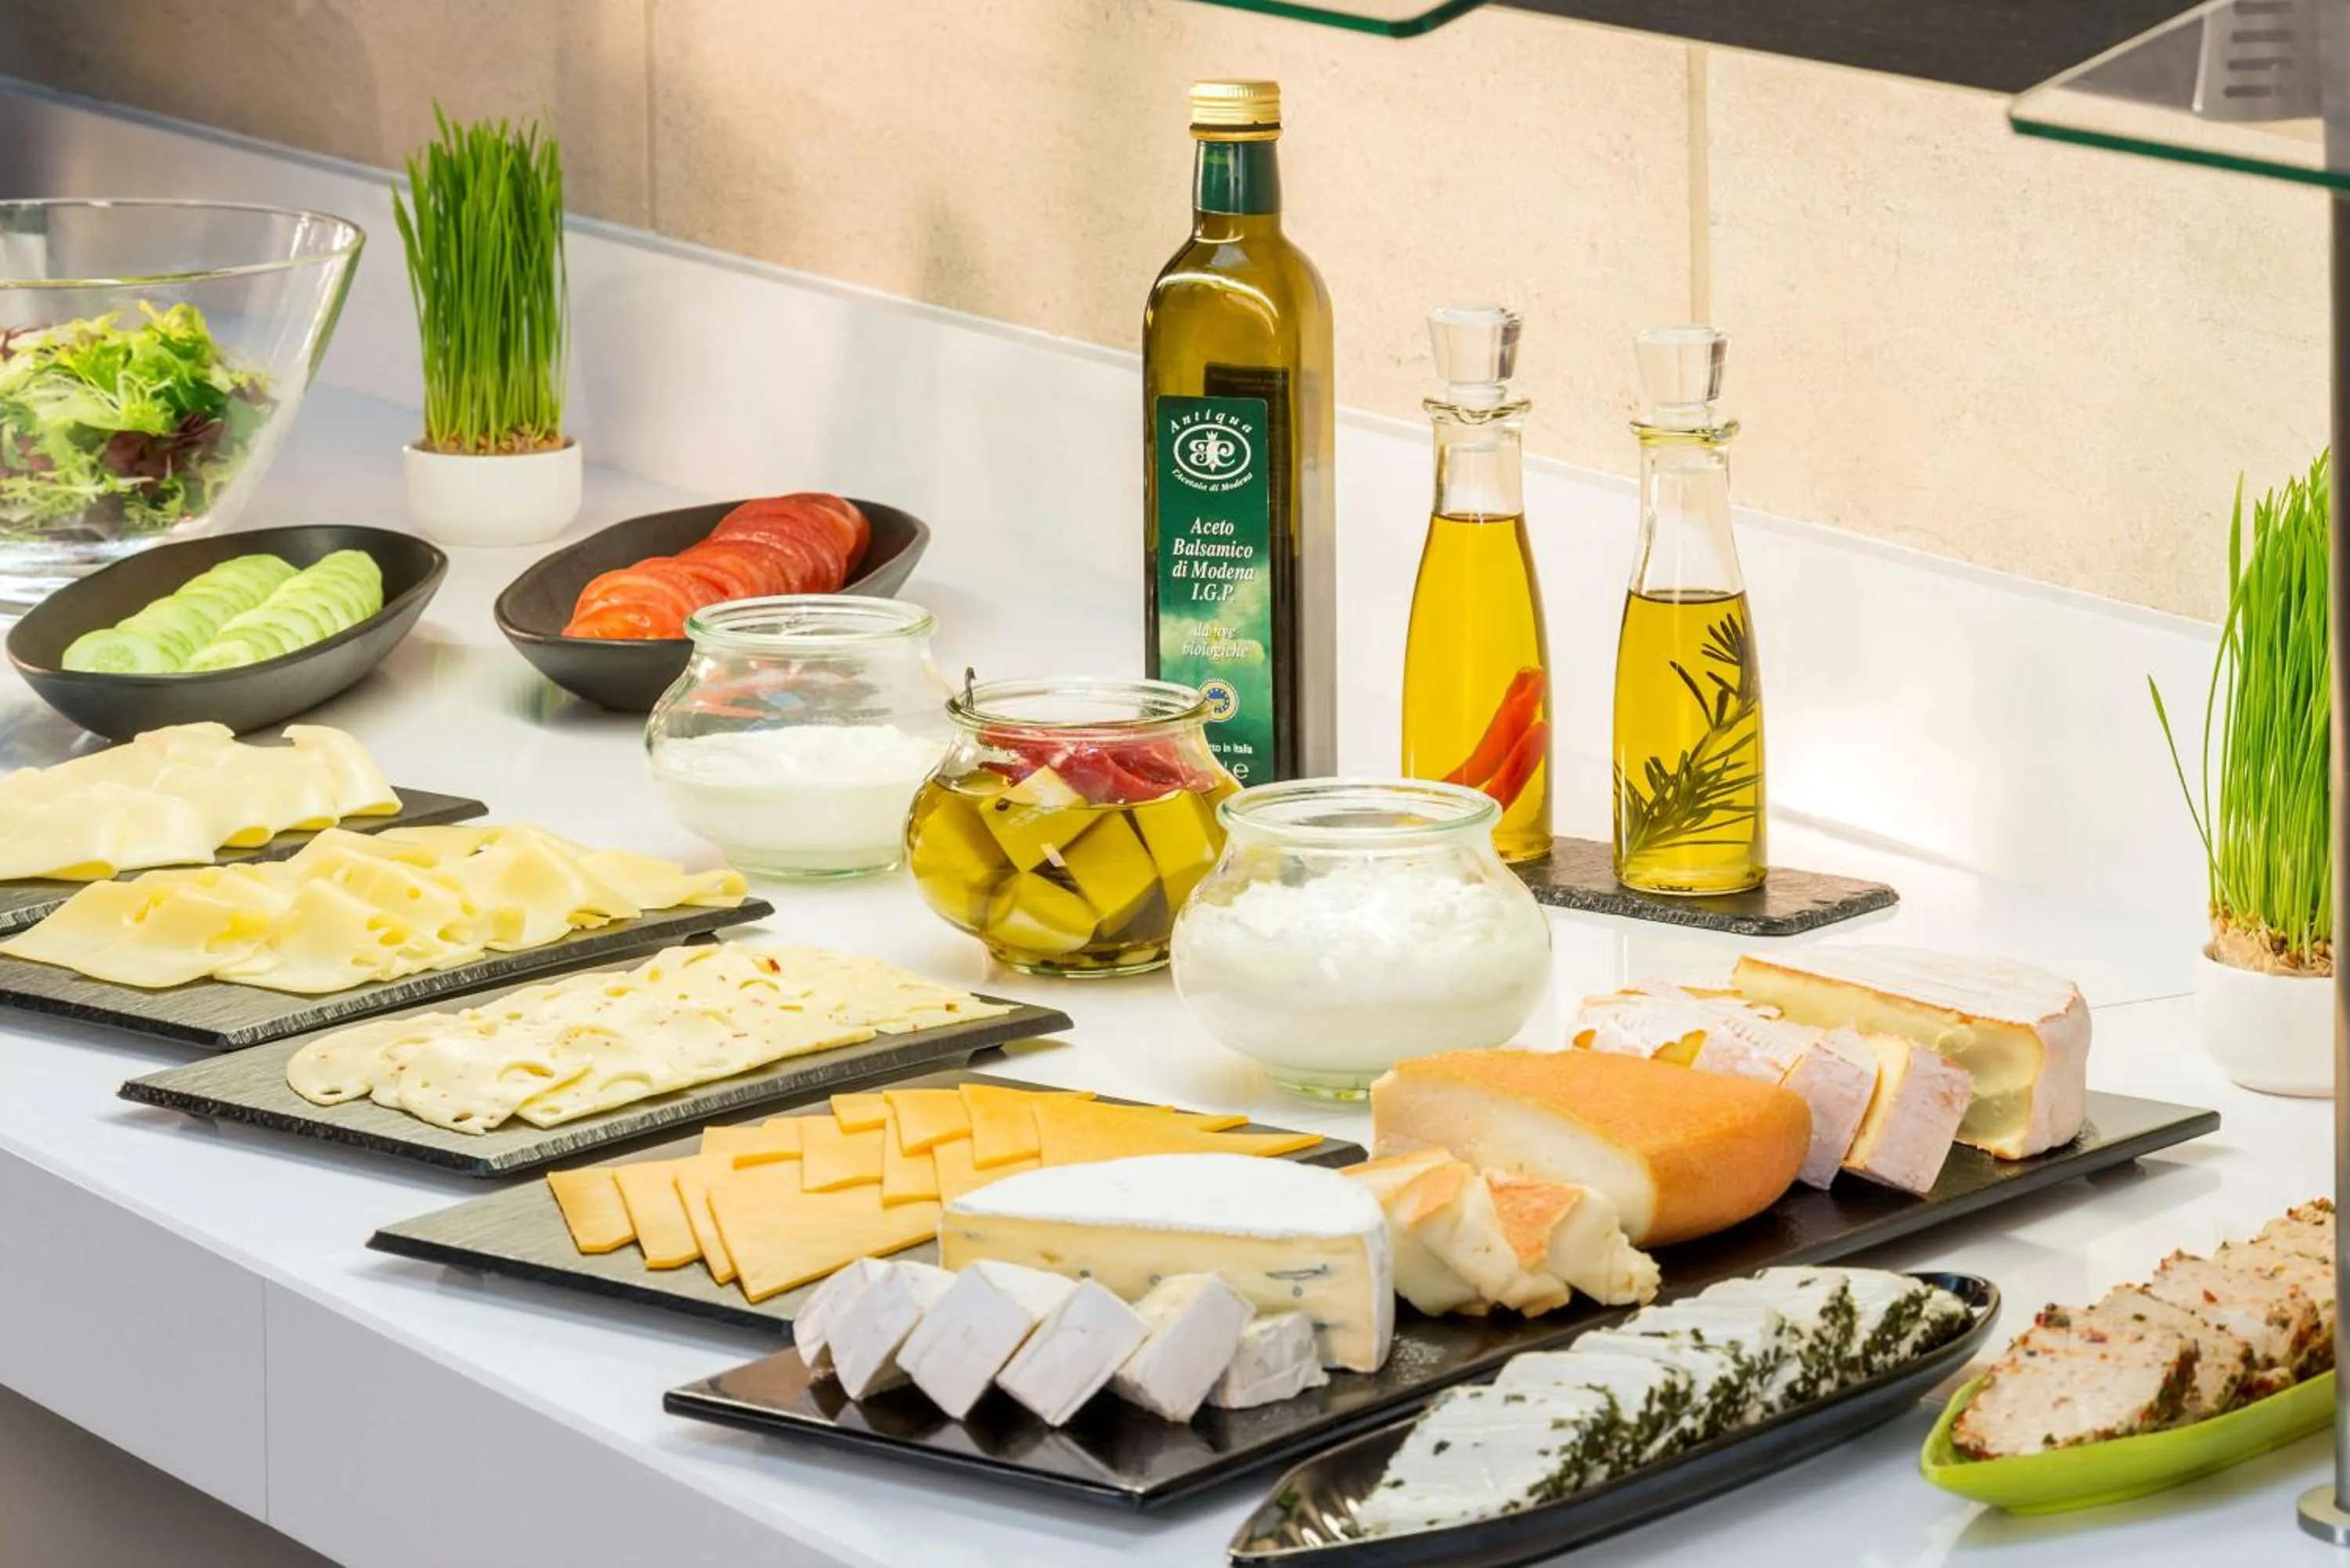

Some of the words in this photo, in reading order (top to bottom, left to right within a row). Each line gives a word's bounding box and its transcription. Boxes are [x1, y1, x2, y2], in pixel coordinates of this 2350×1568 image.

[1170, 409, 1253, 433] Antiqua
[1209, 483, 1220, 492] di
[1191, 517, 1235, 536] Aceto
[1173, 538, 1253, 558] Balsamico
[1172, 560, 1188, 578] di
[1191, 561, 1255, 581] Modena
[1223, 742, 1231, 753] in
[1232, 742, 1253, 754] Italia
